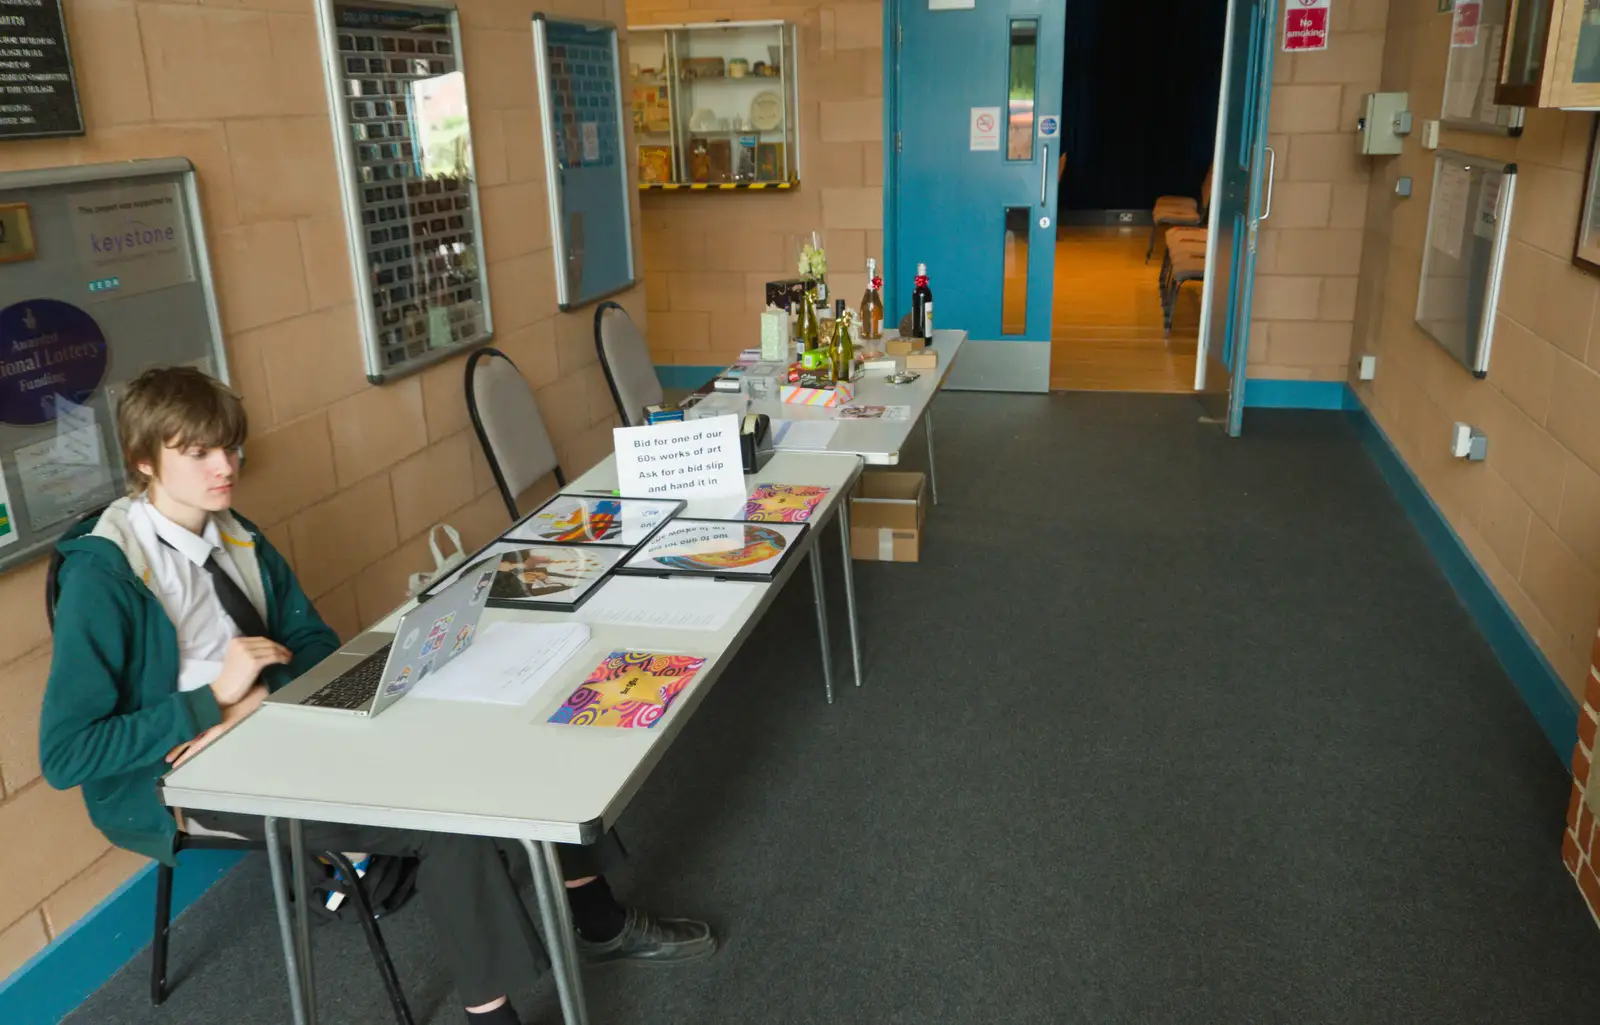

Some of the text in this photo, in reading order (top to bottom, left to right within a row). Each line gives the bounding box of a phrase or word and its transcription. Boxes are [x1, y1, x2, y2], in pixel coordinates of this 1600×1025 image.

[1300, 19, 1312, 27] No
[1287, 29, 1325, 38] smoking
[90, 227, 173, 252] keystone
[0, 342, 98, 379] ional Lottery
[634, 440, 651, 448] Bid
[672, 436, 690, 444] one
[693, 432, 702, 440] of
[637, 445, 721, 463] 60s works of art
[639, 471, 658, 479] Ask
[688, 464, 702, 472] bid
[706, 461, 724, 470] slip
[648, 484, 667, 493] and
[670, 480, 694, 490] hand
[708, 477, 717, 485] in
